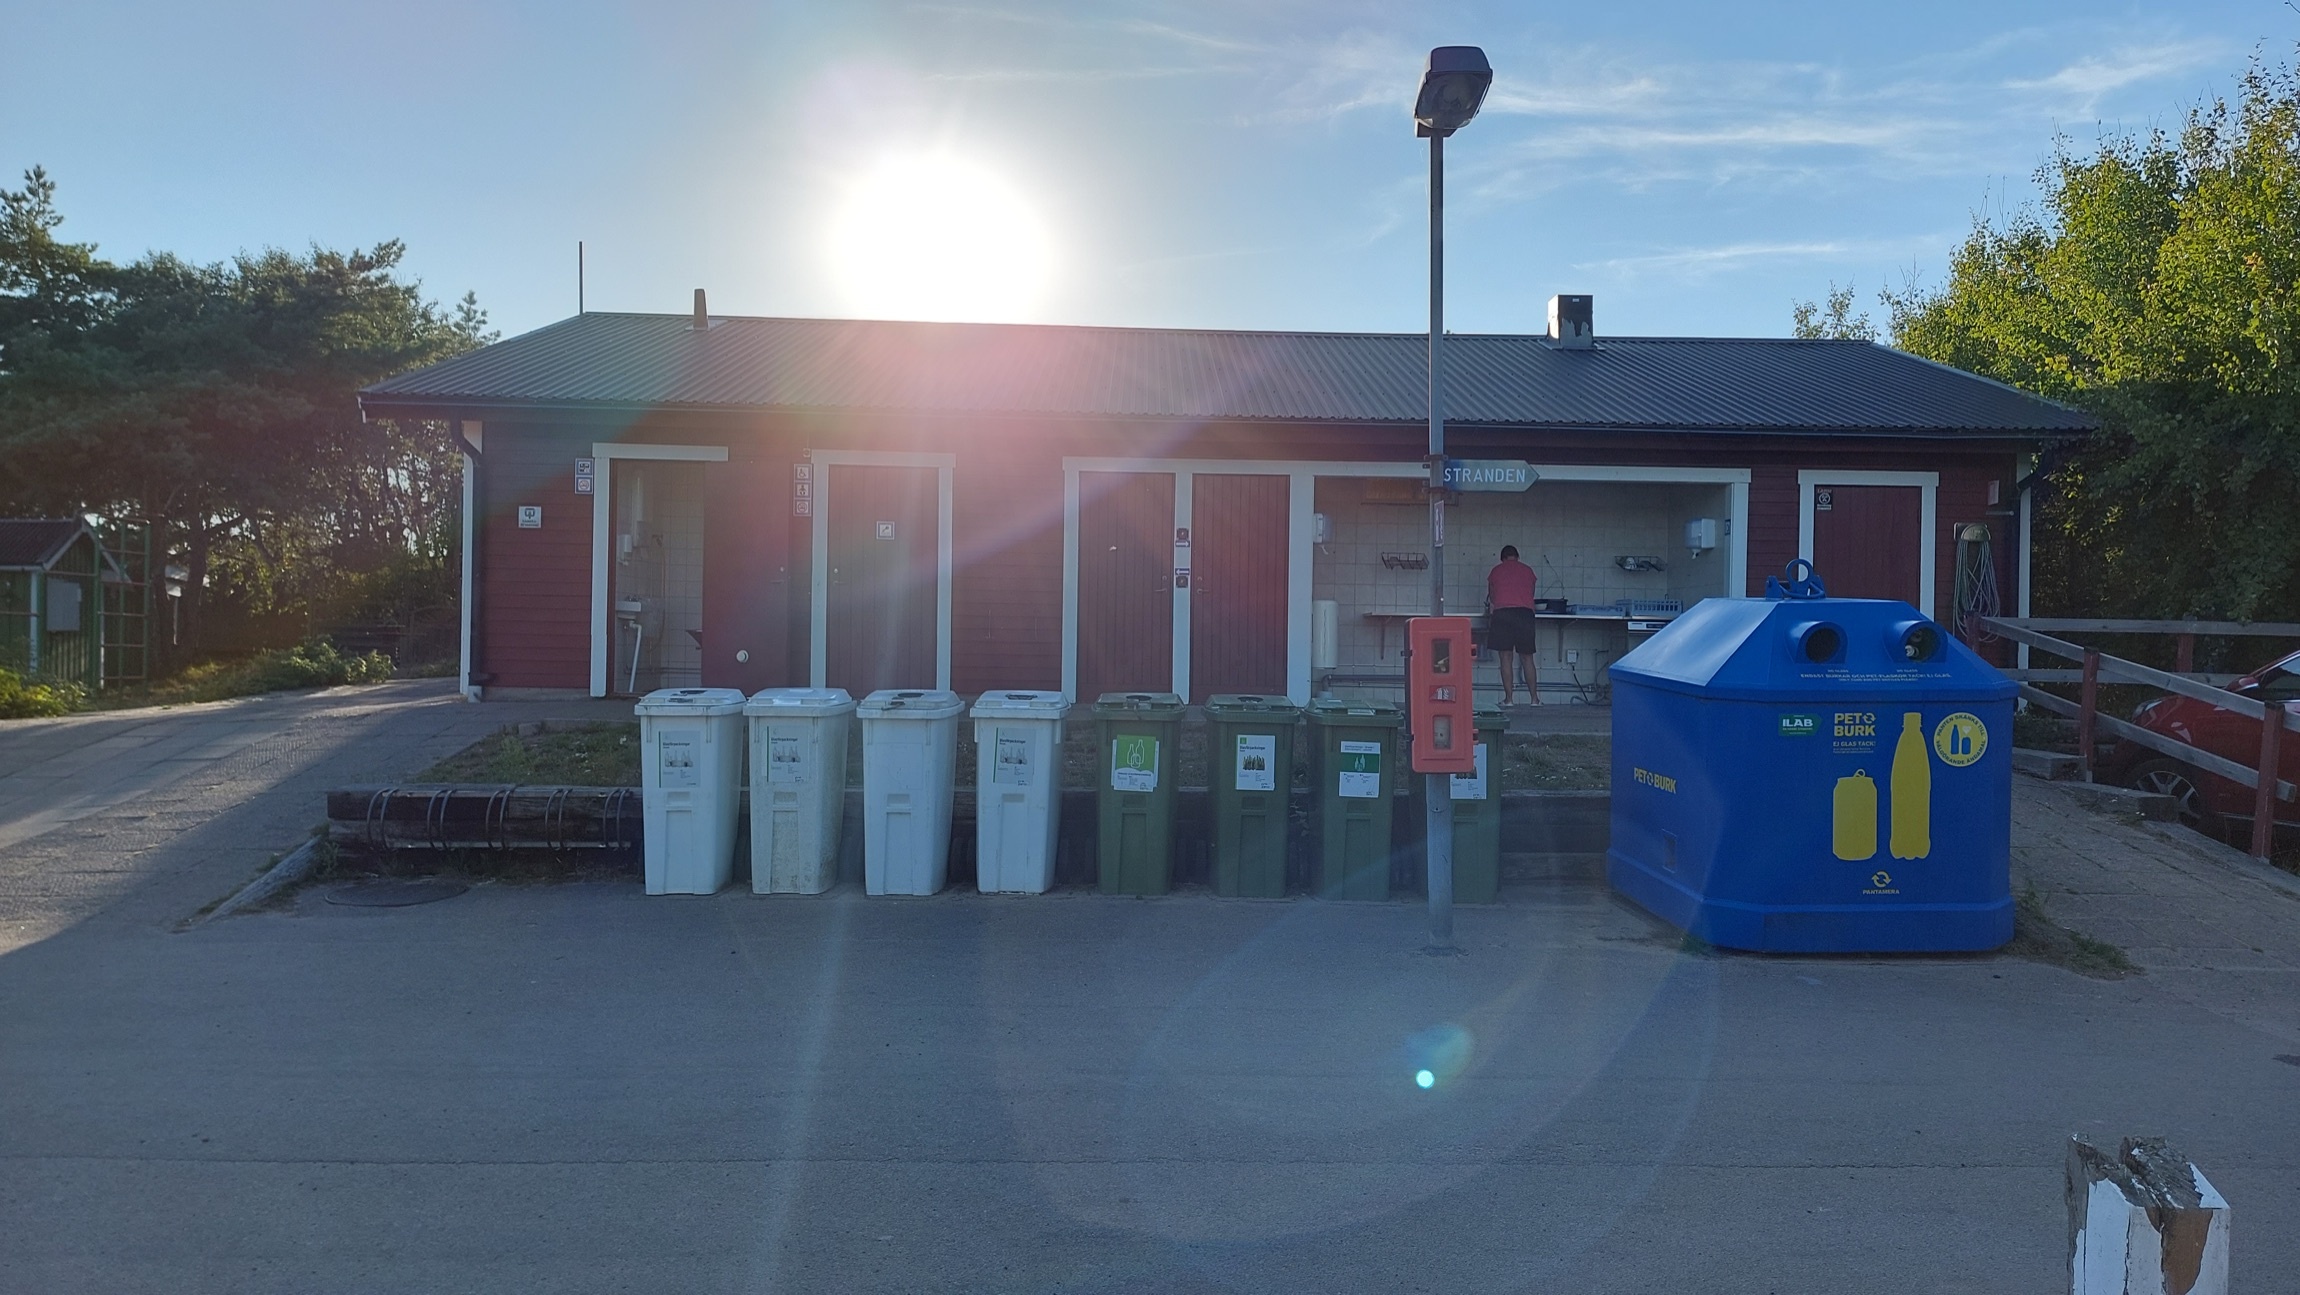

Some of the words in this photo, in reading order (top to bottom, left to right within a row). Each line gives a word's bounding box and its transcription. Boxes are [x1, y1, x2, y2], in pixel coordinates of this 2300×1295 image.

[1443, 467, 1526, 483] STRANDEN
[1782, 718, 1813, 727] ILAB
[1834, 712, 1862, 724] PET
[1833, 725, 1876, 737] BURK
[1633, 767, 1648, 784] PET
[1653, 773, 1677, 795] BURK
